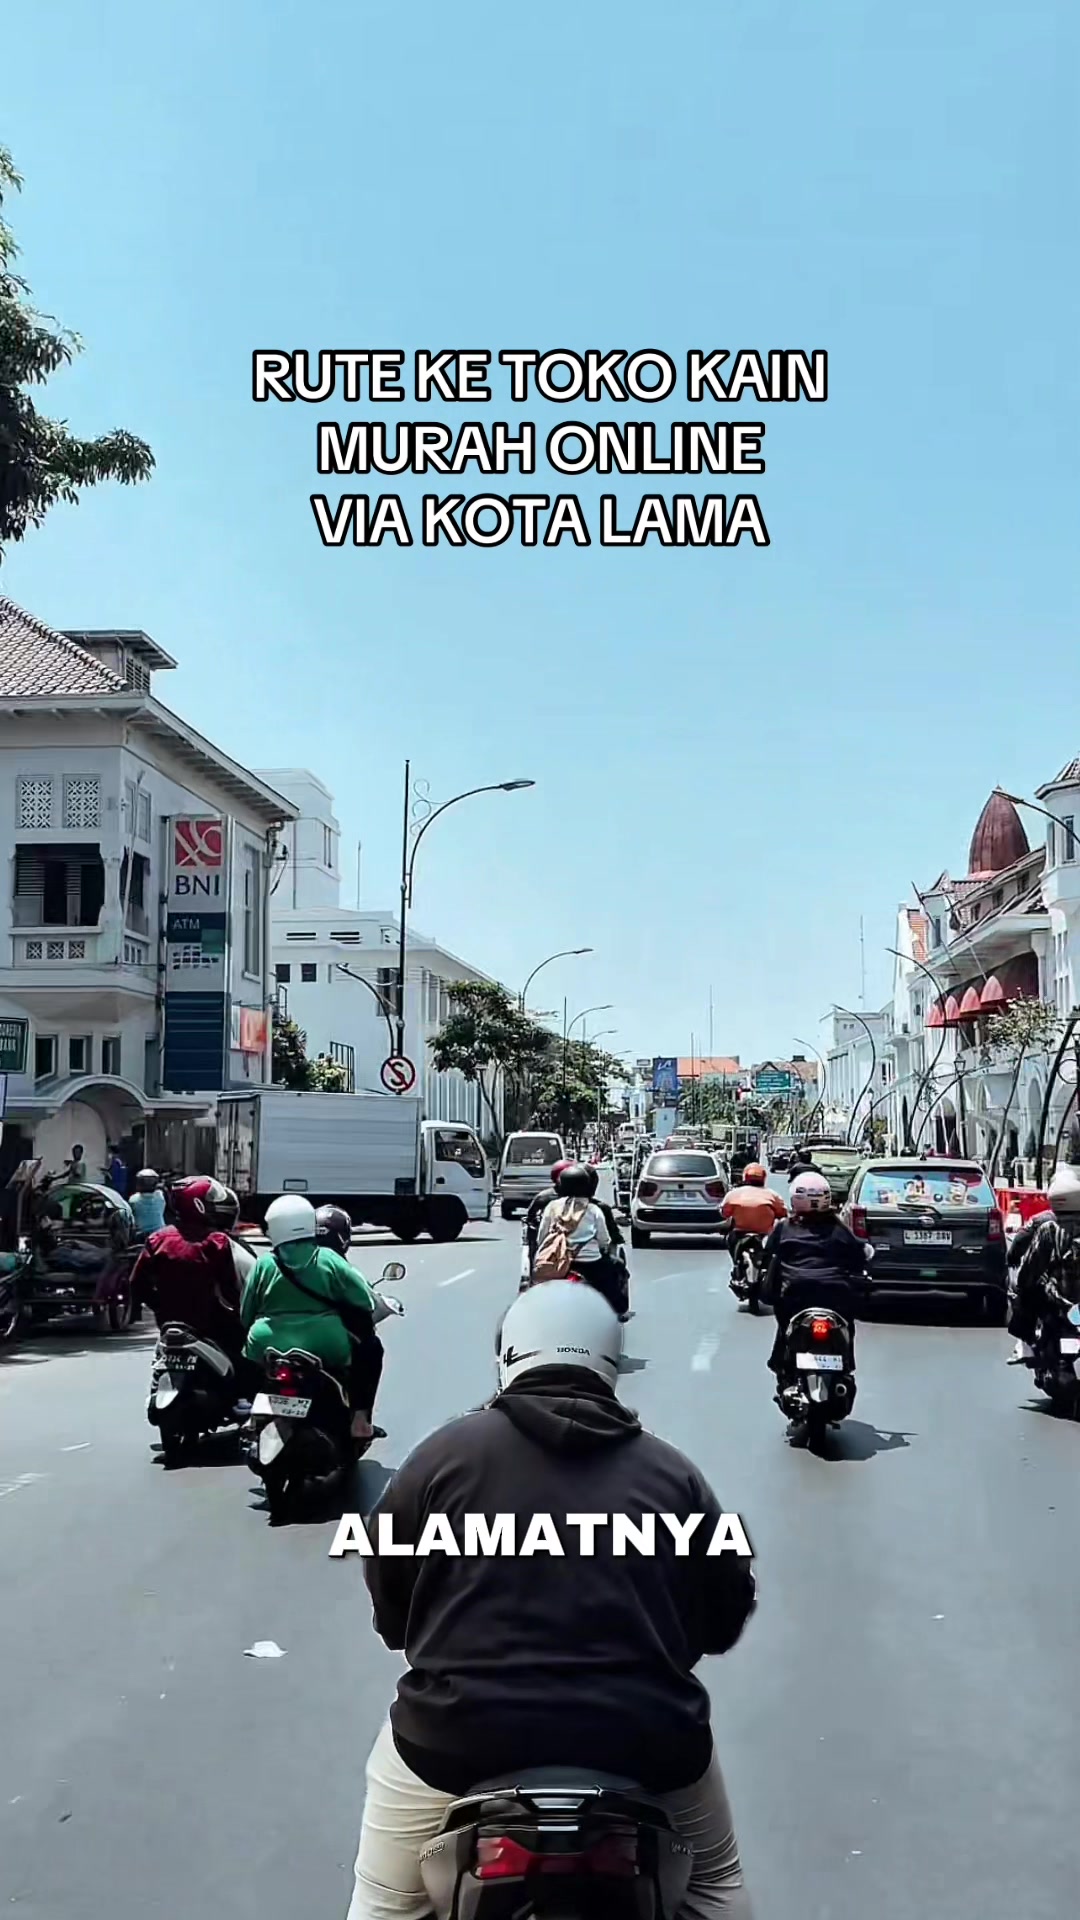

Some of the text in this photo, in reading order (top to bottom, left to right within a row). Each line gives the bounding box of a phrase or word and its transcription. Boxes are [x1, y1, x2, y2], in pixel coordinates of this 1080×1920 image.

[174, 874, 220, 897] BNI
[172, 917, 201, 931] ATM
[556, 1346, 591, 1357] HONDA
